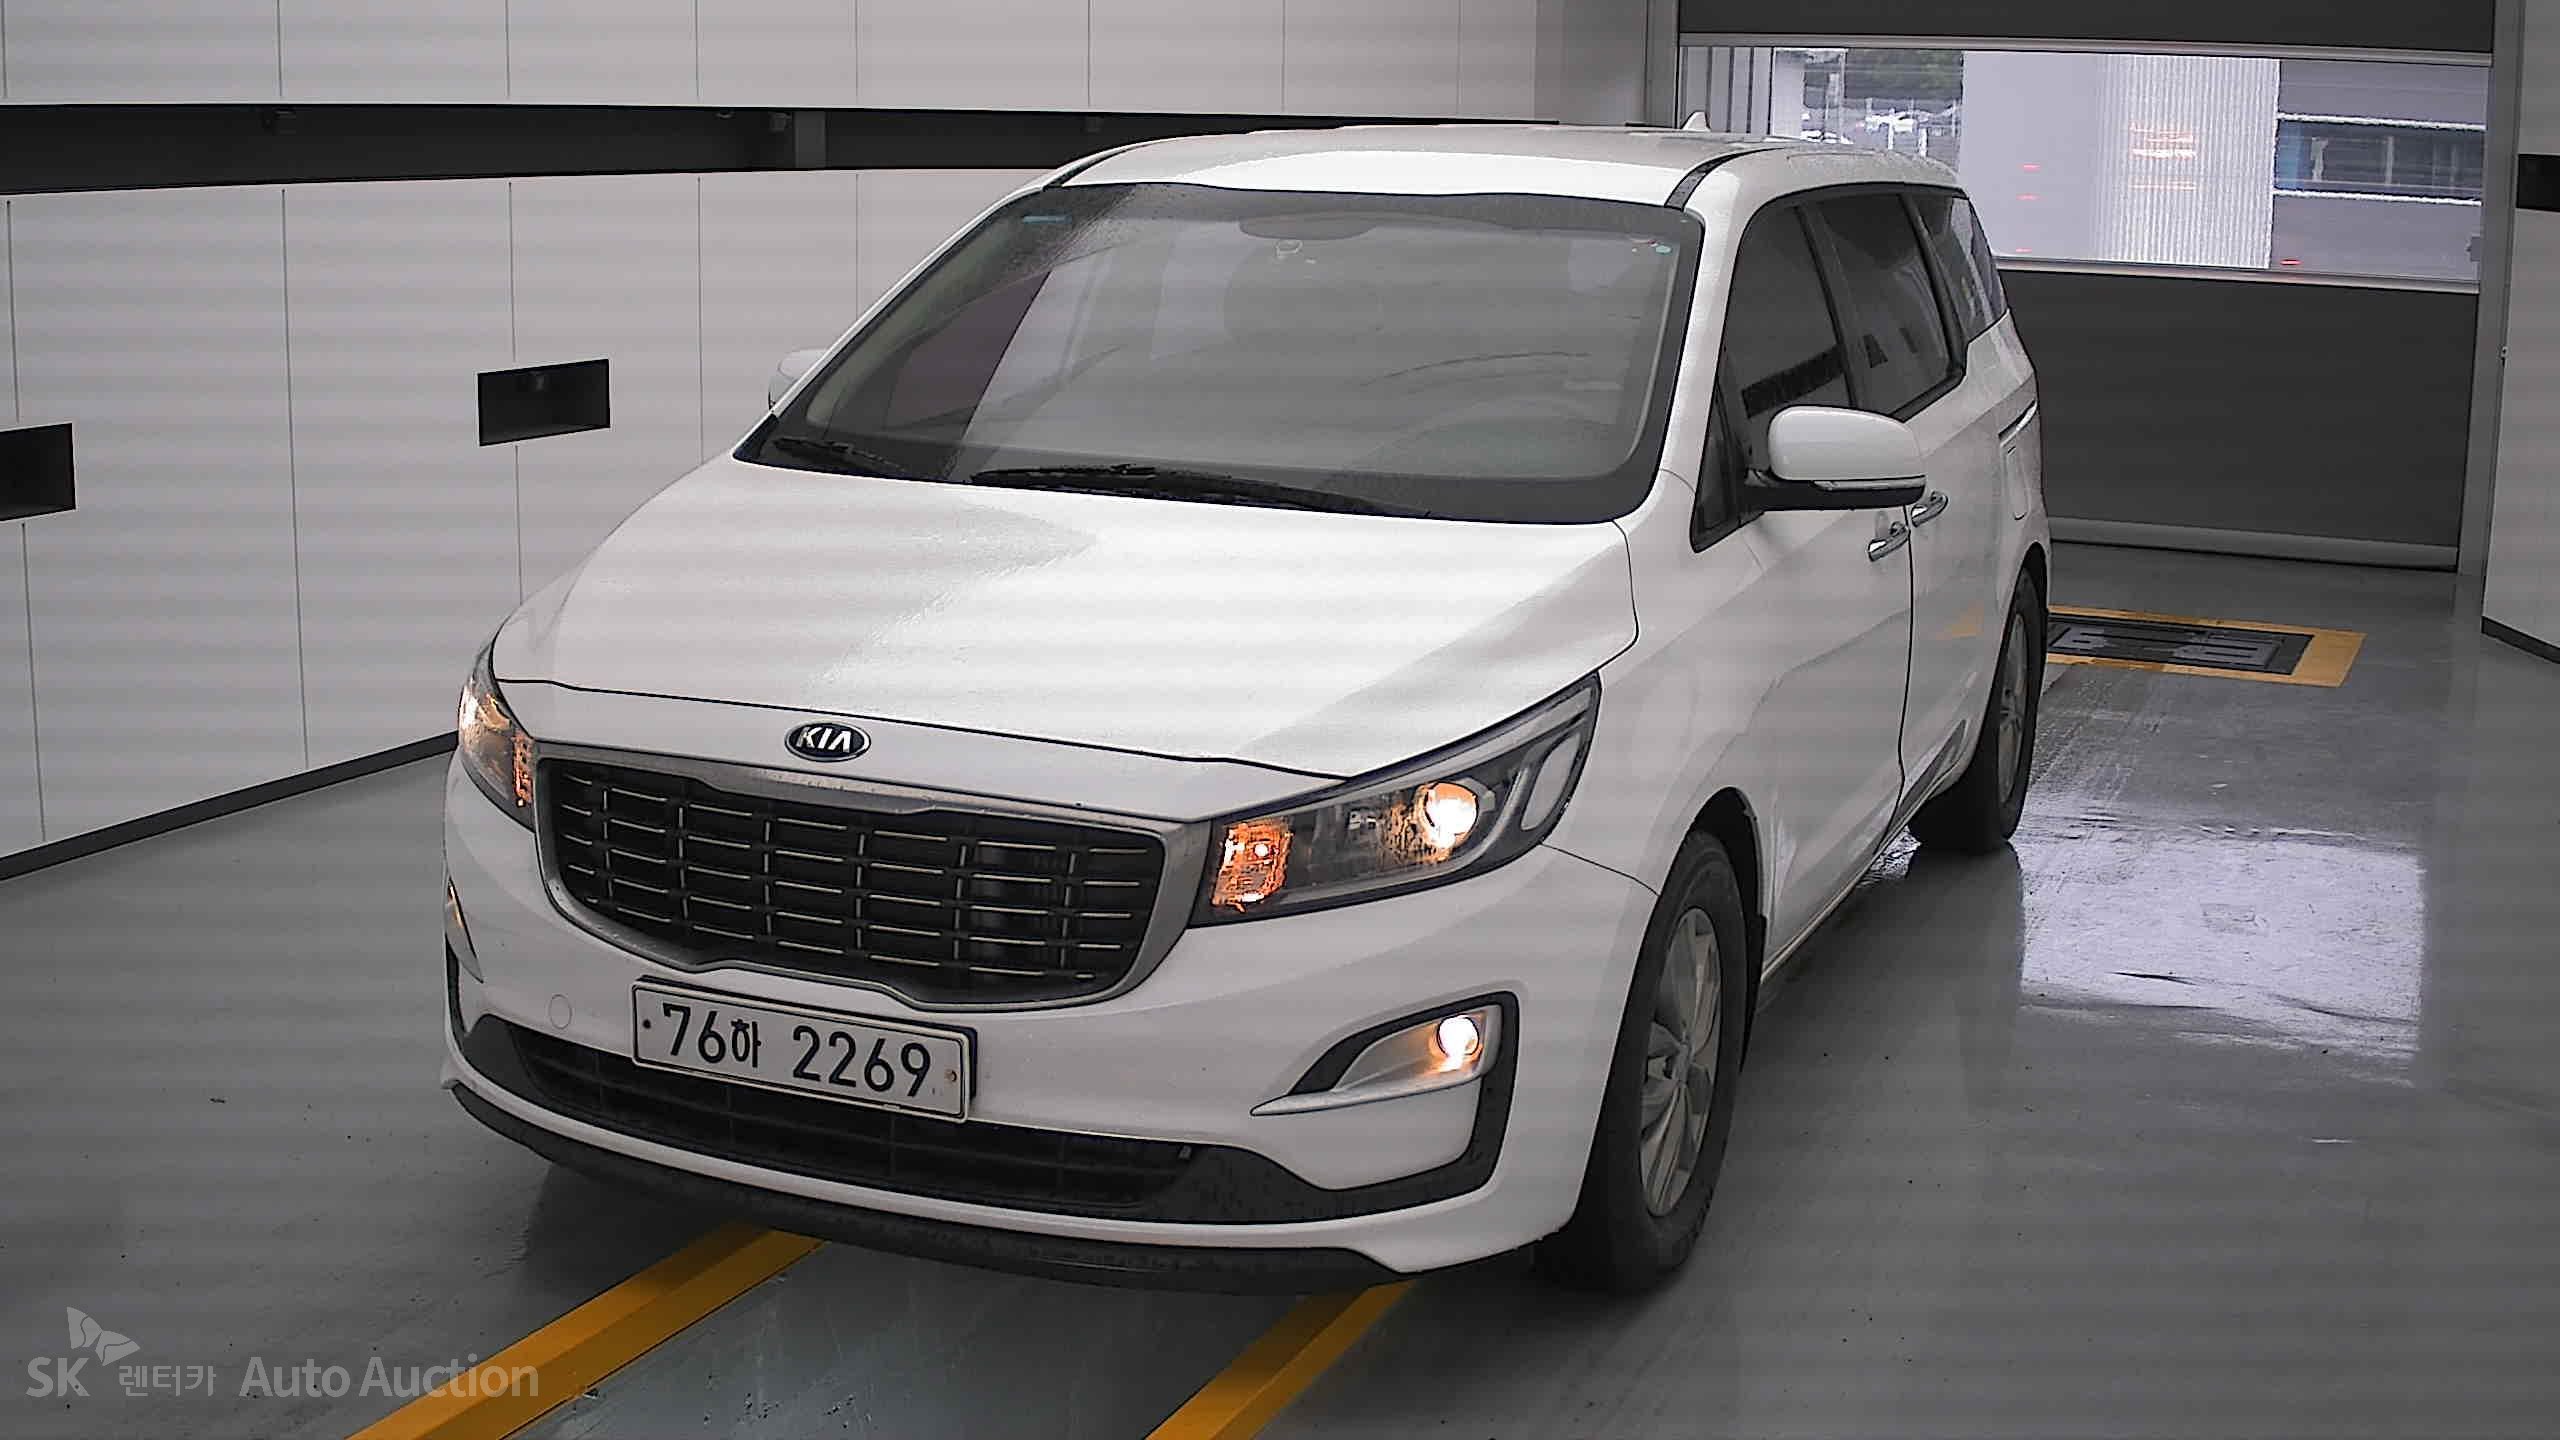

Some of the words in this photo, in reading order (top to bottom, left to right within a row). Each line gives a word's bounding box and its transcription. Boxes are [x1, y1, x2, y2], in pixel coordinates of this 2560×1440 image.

[795, 726, 852, 753] KIA
[661, 1002, 763, 1069] 76하
[791, 1024, 931, 1097] 2269
